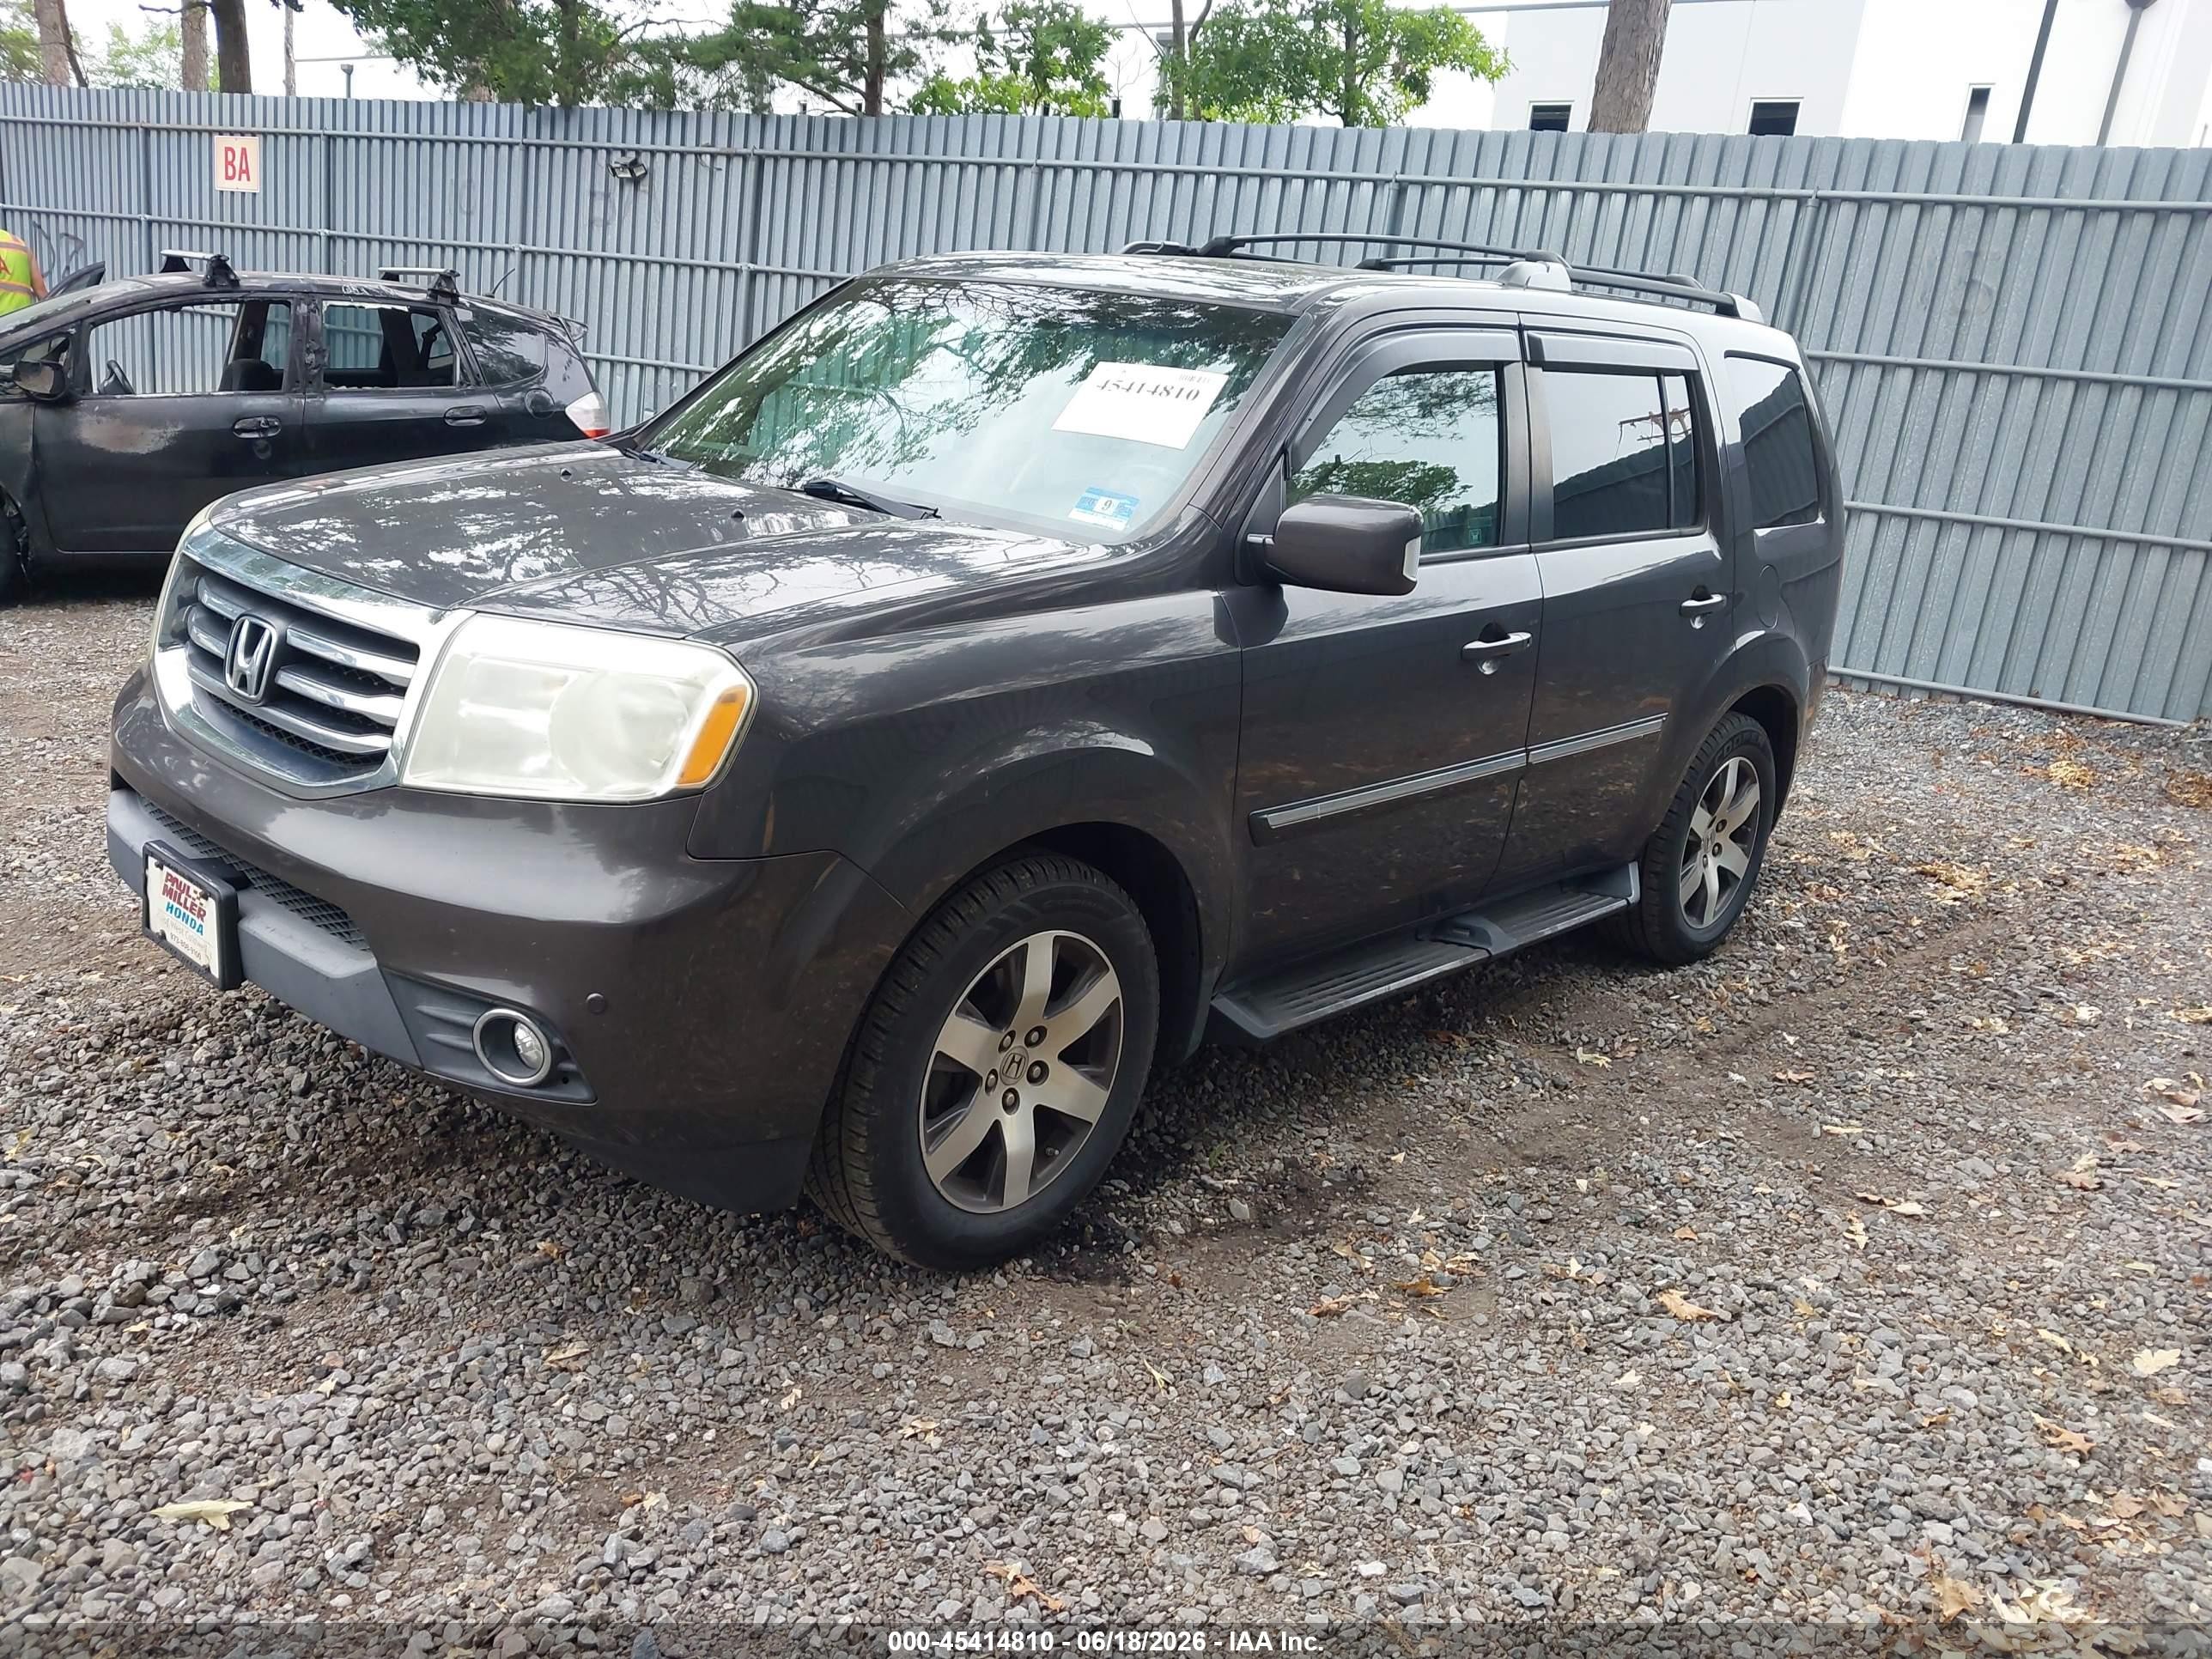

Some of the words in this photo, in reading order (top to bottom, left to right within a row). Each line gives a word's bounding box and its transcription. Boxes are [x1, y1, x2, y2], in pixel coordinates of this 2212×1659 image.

[224, 146, 252, 182] BA
[1097, 379, 1200, 402] 45414810
[1101, 499, 1114, 512] 9
[164, 872, 194, 898] PAUL
[161, 884, 207, 922] MILLER
[165, 902, 204, 936] HONDA
